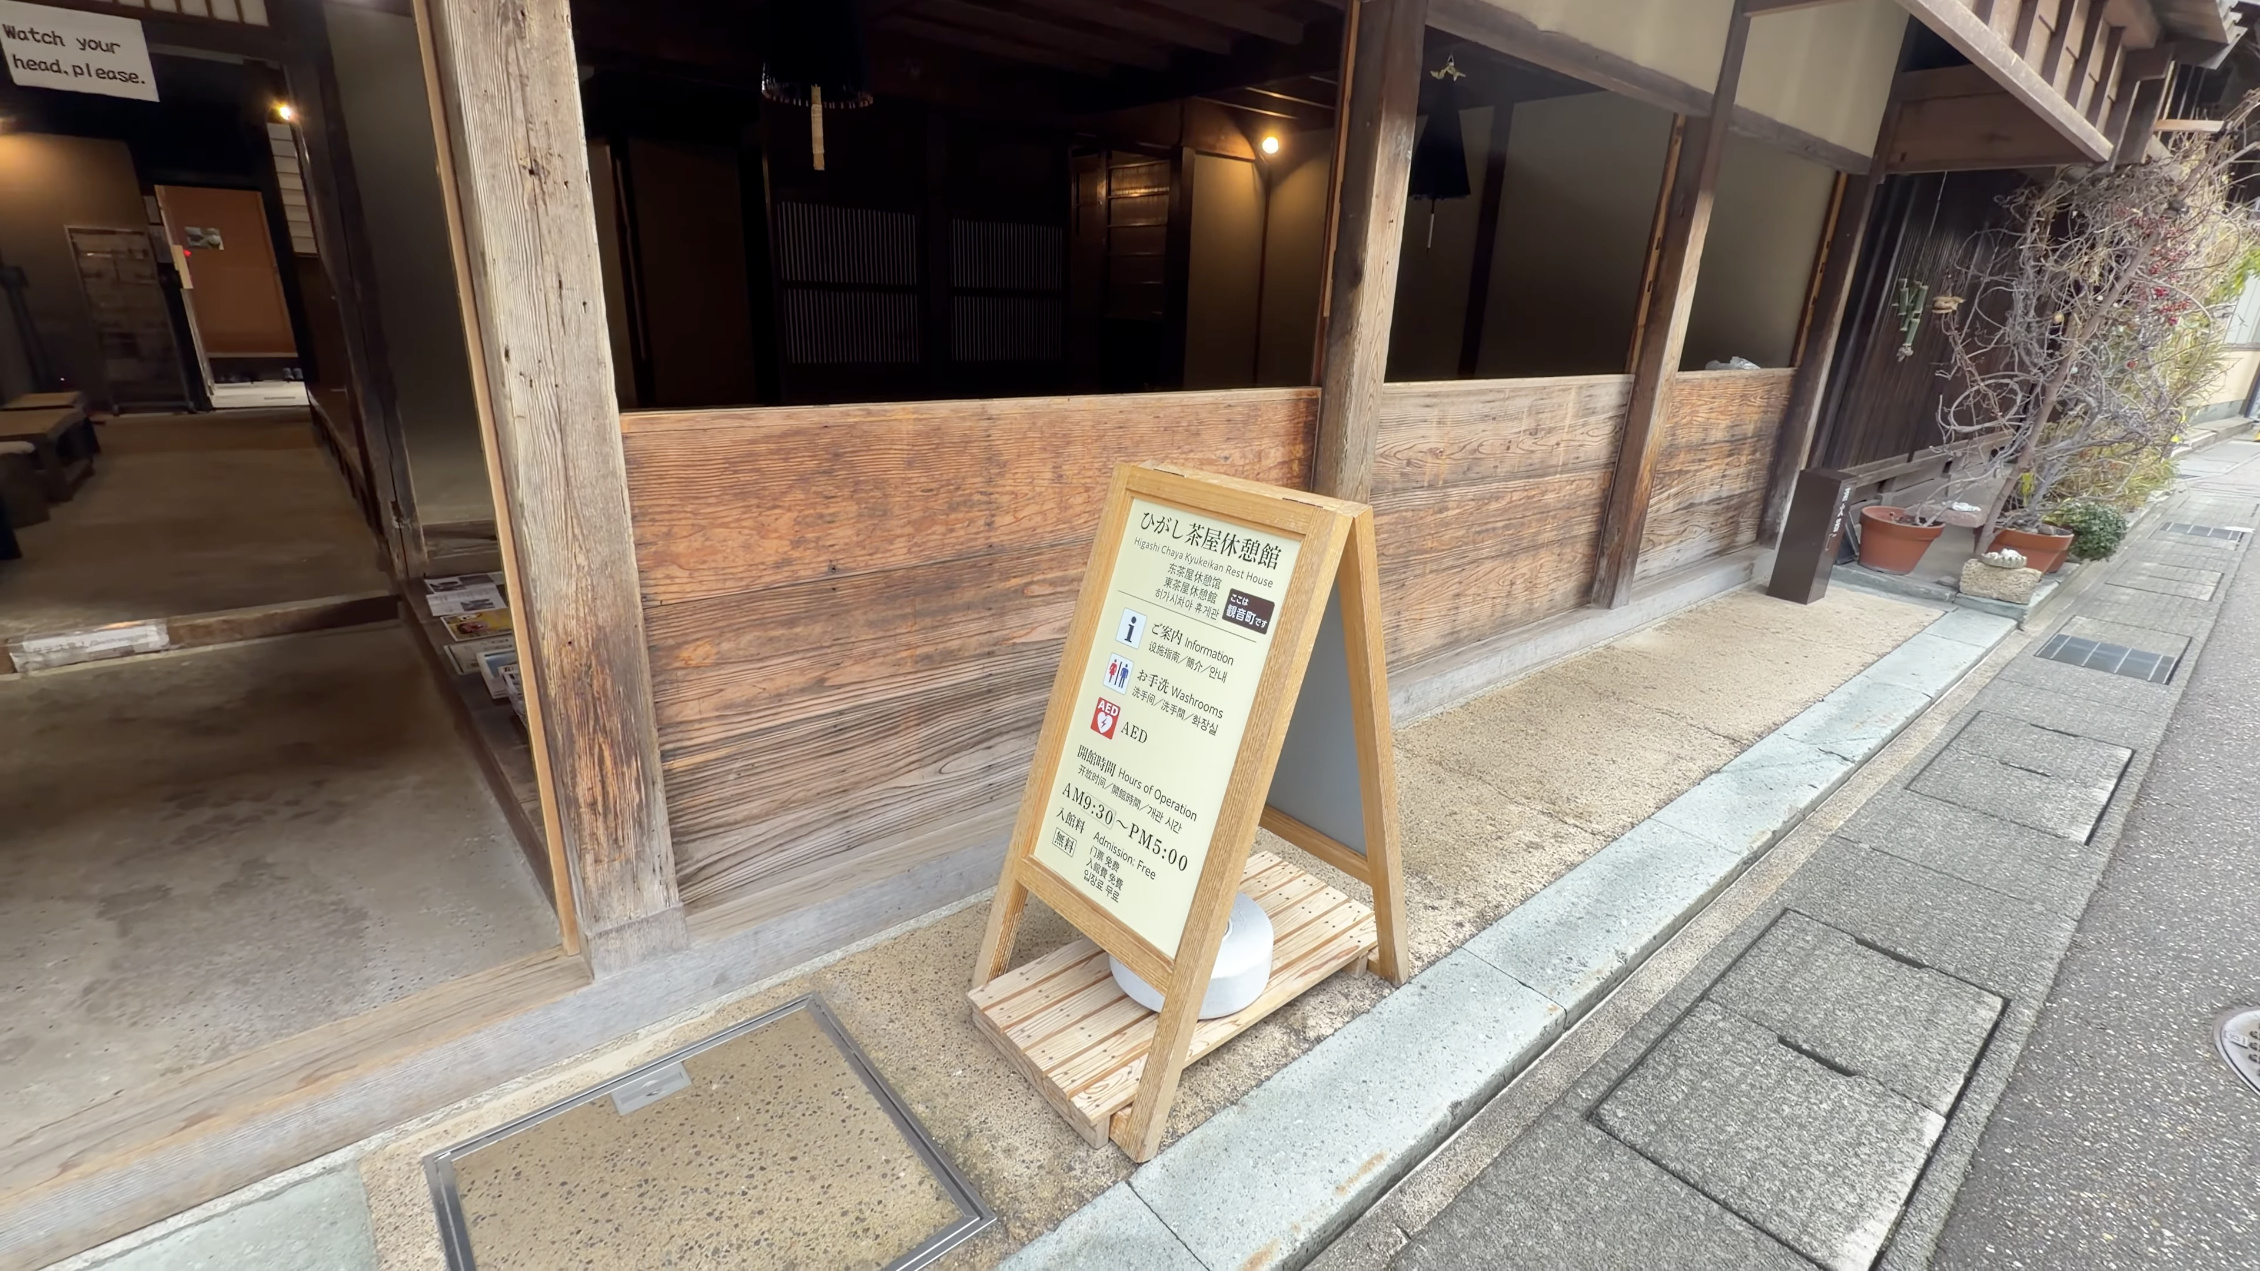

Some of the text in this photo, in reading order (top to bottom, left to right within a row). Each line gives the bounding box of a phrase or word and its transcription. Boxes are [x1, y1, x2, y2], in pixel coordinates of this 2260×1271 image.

[2, 23, 121, 54] Watch your
[1140, 511, 1282, 570] ひがし茶屋休憩館
[1134, 536, 1274, 588] Higashi Chaya Kyukeikan Rest House
[1167, 563, 1222, 590] 东茶屋休憩馆
[1155, 588, 1220, 621] 히가시차야 휴게관
[1163, 577, 1218, 605] 東茶屋休憩館
[1230, 593, 1249, 605] ここは
[1225, 604, 1268, 629] 観音町です
[1151, 622, 1235, 666] ご案内 Information
[1097, 699, 1120, 716] AED
[1136, 669, 1224, 719] お手洗 Washrooms
[1120, 721, 1148, 744] AED
[1077, 744, 1198, 822] 開館時間 Hours of Operation
[1056, 807, 1086, 835] 入館料
[1054, 831, 1075, 855] 無料
[1093, 831, 1157, 881] Admission: Free
[1086, 858, 1124, 891] 入館費 免費
[1089, 845, 1120, 874] 门票 免费
[1083, 869, 1120, 903] 입장료 무료
